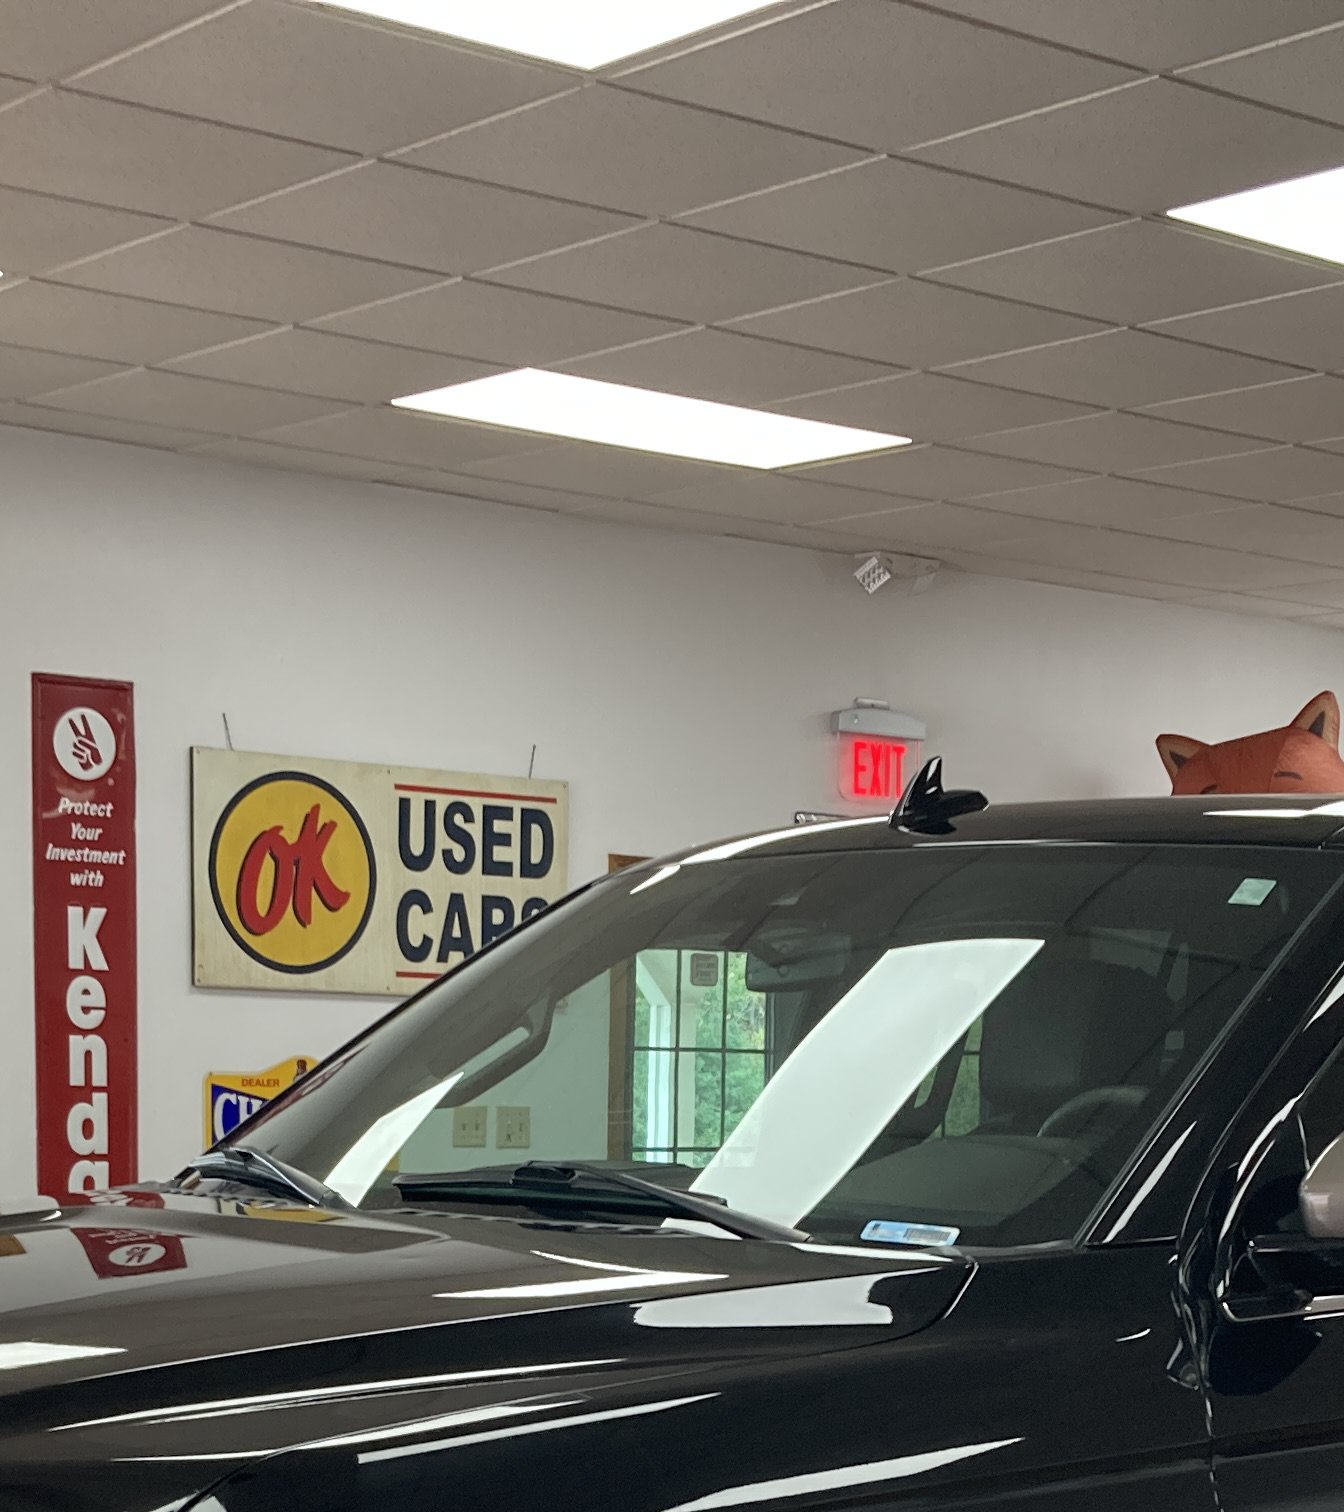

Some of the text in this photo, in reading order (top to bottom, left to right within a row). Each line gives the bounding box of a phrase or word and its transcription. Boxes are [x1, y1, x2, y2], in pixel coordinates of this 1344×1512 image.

[853, 740, 906, 798] EXIT
[57, 797, 114, 818] Protect
[70, 822, 103, 841] Your
[398, 797, 555, 879] USED
[45, 843, 127, 865] Investment
[69, 870, 104, 888] with
[236, 803, 351, 937] OK
[241, 1078, 281, 1088] DEALER
